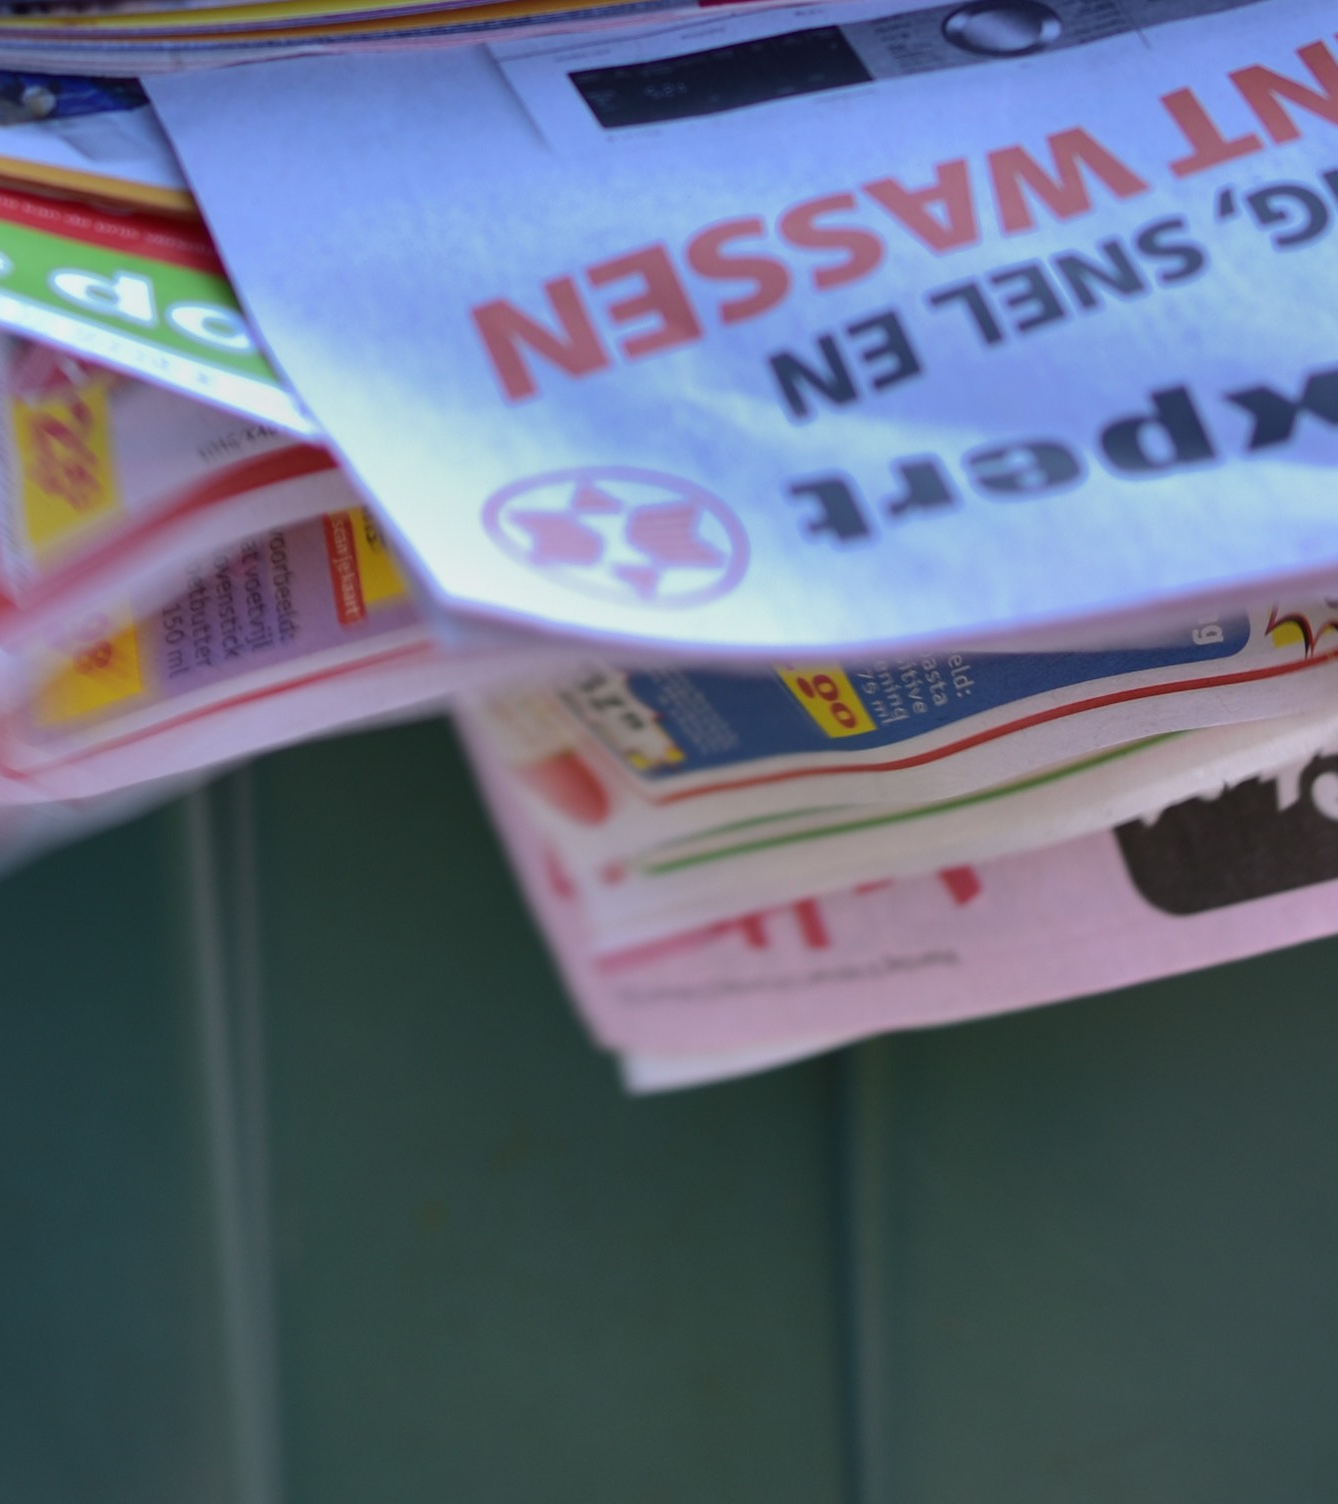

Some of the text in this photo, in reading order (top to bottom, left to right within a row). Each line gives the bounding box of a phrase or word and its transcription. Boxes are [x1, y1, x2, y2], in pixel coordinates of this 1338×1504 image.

[468, 126, 1147, 403] WASSEN
[929, 216, 1206, 347] SNEL
[766, 310, 924, 428] EN
